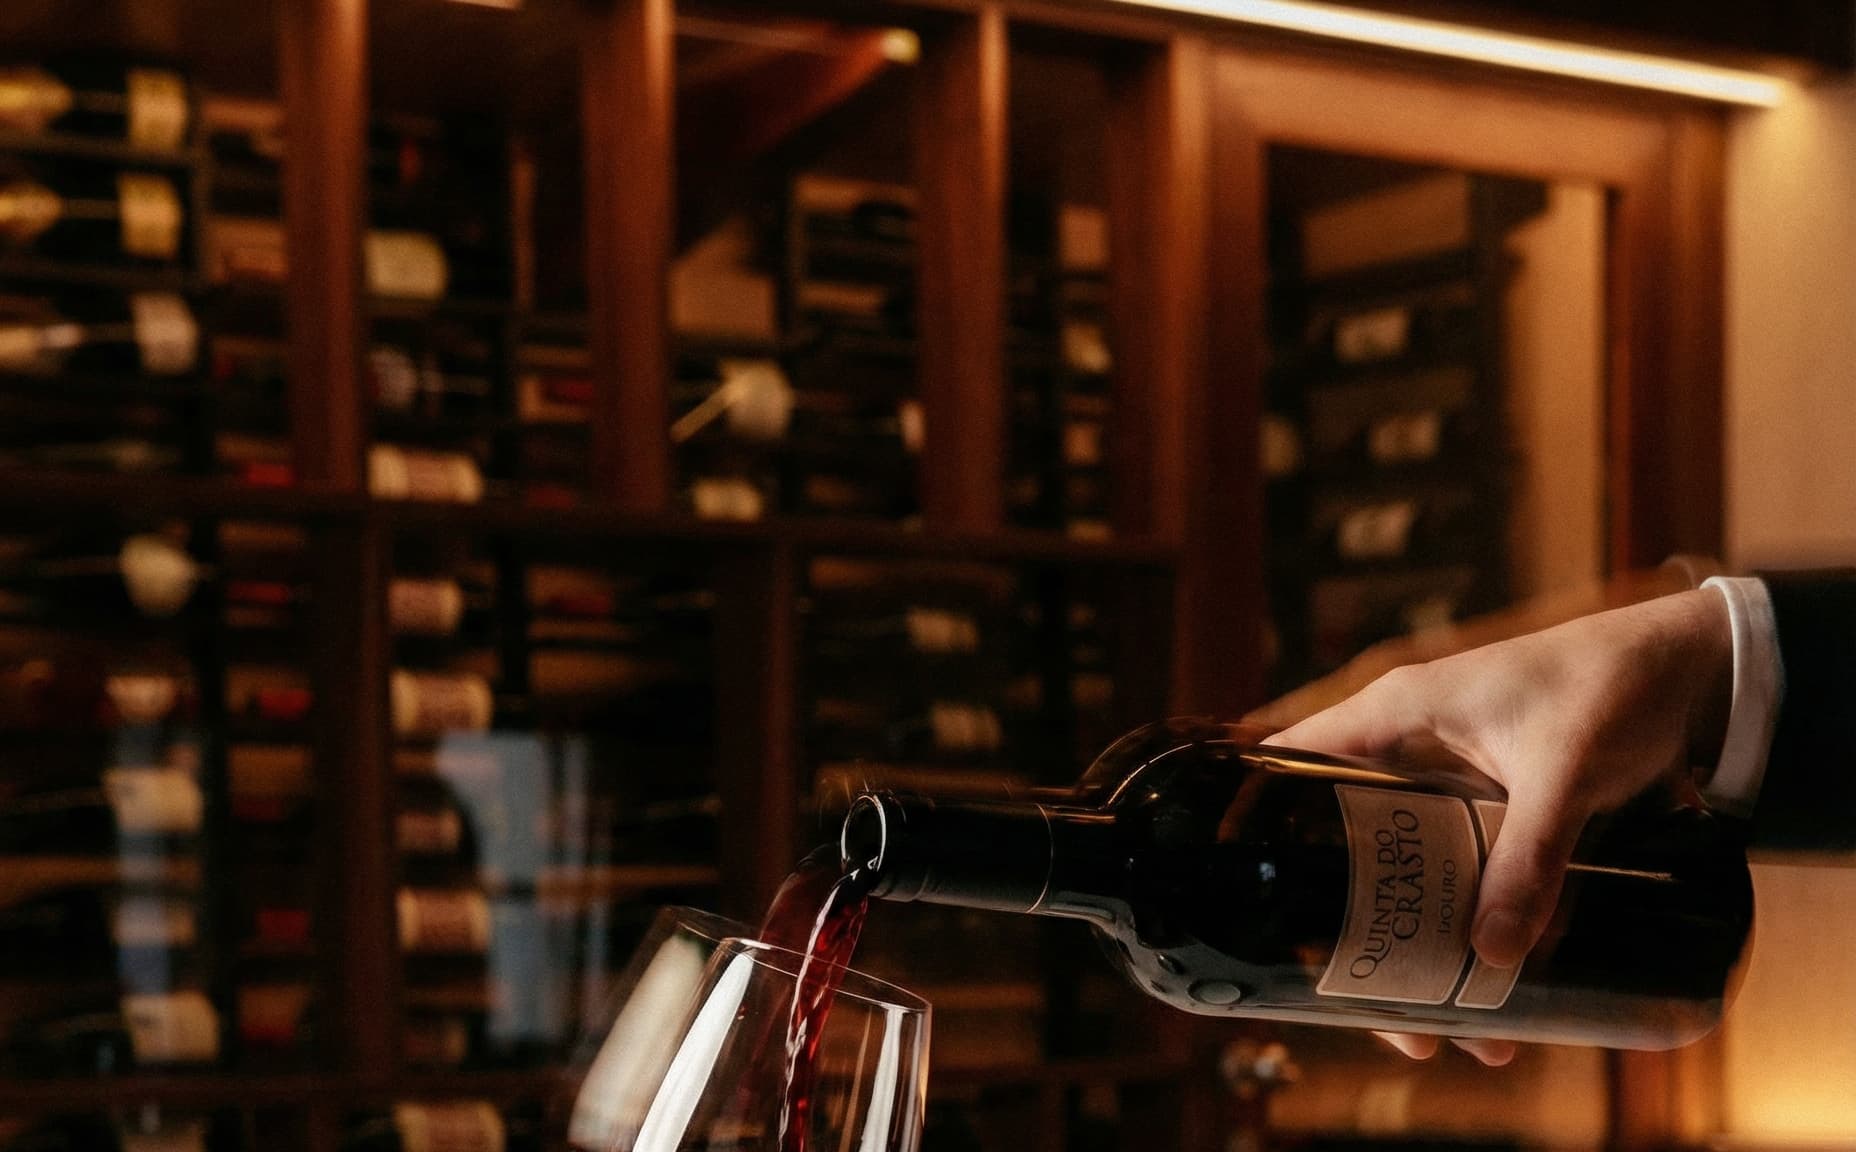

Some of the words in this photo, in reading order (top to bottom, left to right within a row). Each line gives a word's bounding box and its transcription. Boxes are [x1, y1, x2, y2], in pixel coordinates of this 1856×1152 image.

[1351, 874, 1396, 979] QUINTA
[1375, 829, 1396, 867] DO
[1391, 809, 1424, 940] CRASTO
